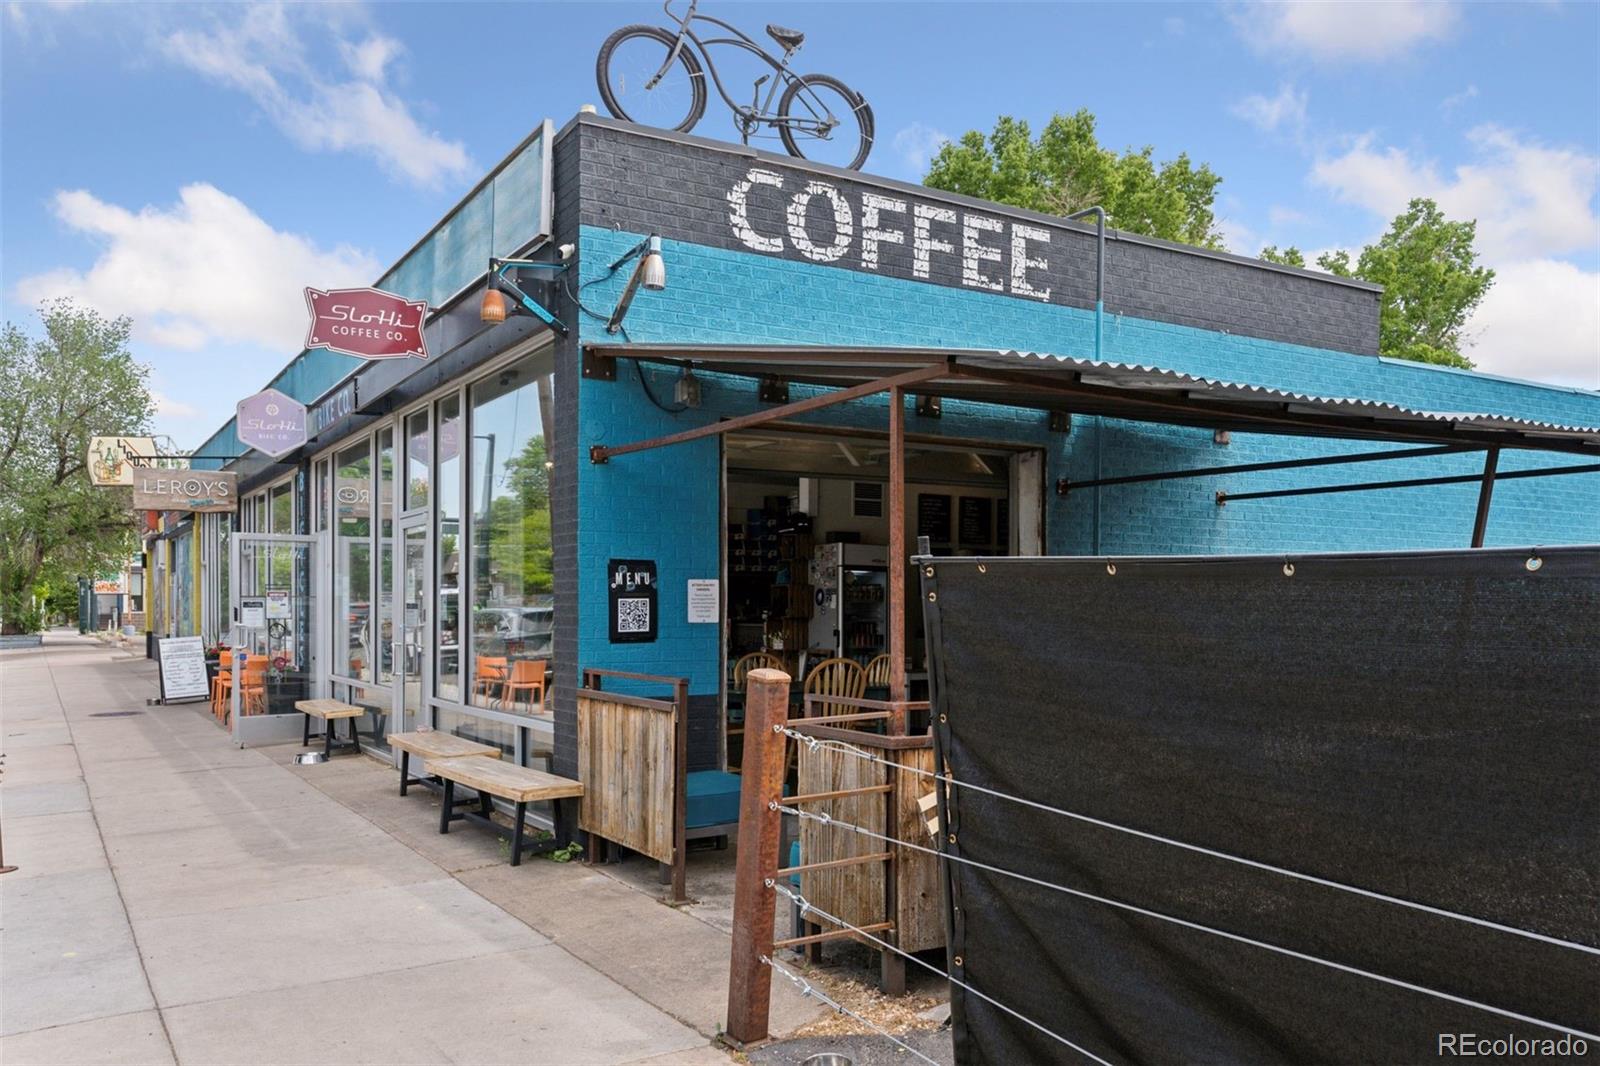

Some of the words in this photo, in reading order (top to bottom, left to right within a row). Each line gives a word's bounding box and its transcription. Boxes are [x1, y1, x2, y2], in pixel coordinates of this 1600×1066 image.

[726, 168, 1051, 302] COFFEE
[320, 305, 415, 328] SloHi
[331, 325, 380, 339] COFFEE
[386, 331, 408, 342] CO.
[317, 398, 335, 430] BIKE
[338, 388, 351, 417] CO.
[143, 478, 228, 497] LEROY'S
[615, 571, 650, 585] MENU
